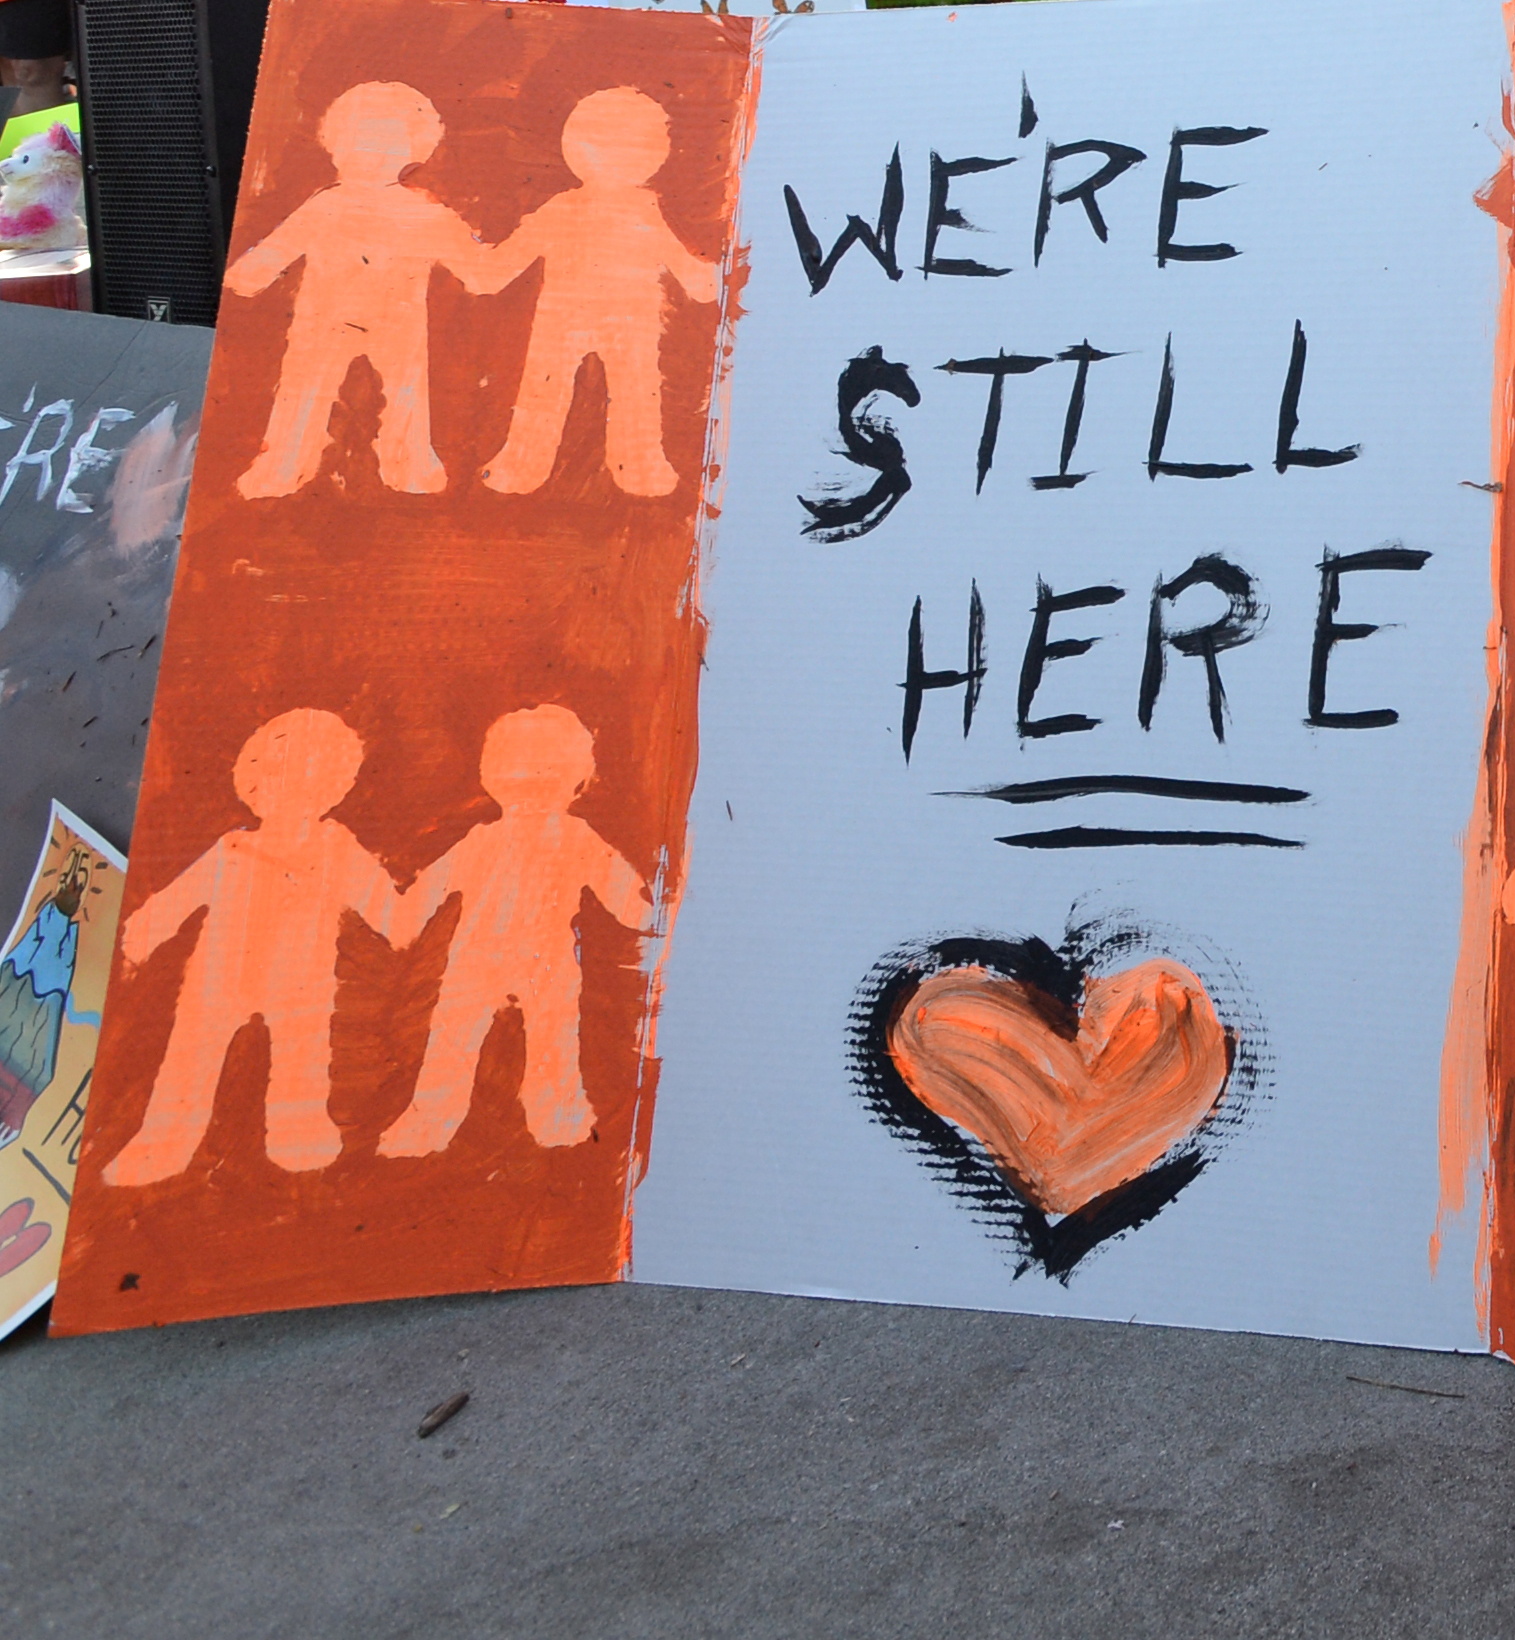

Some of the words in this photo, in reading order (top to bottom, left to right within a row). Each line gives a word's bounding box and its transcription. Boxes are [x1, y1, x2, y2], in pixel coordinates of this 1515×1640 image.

[782, 70, 1270, 298] WE'RE
[0, 381, 137, 513] 'RE
[797, 318, 1364, 544] STILL
[896, 542, 1434, 766] HERE
